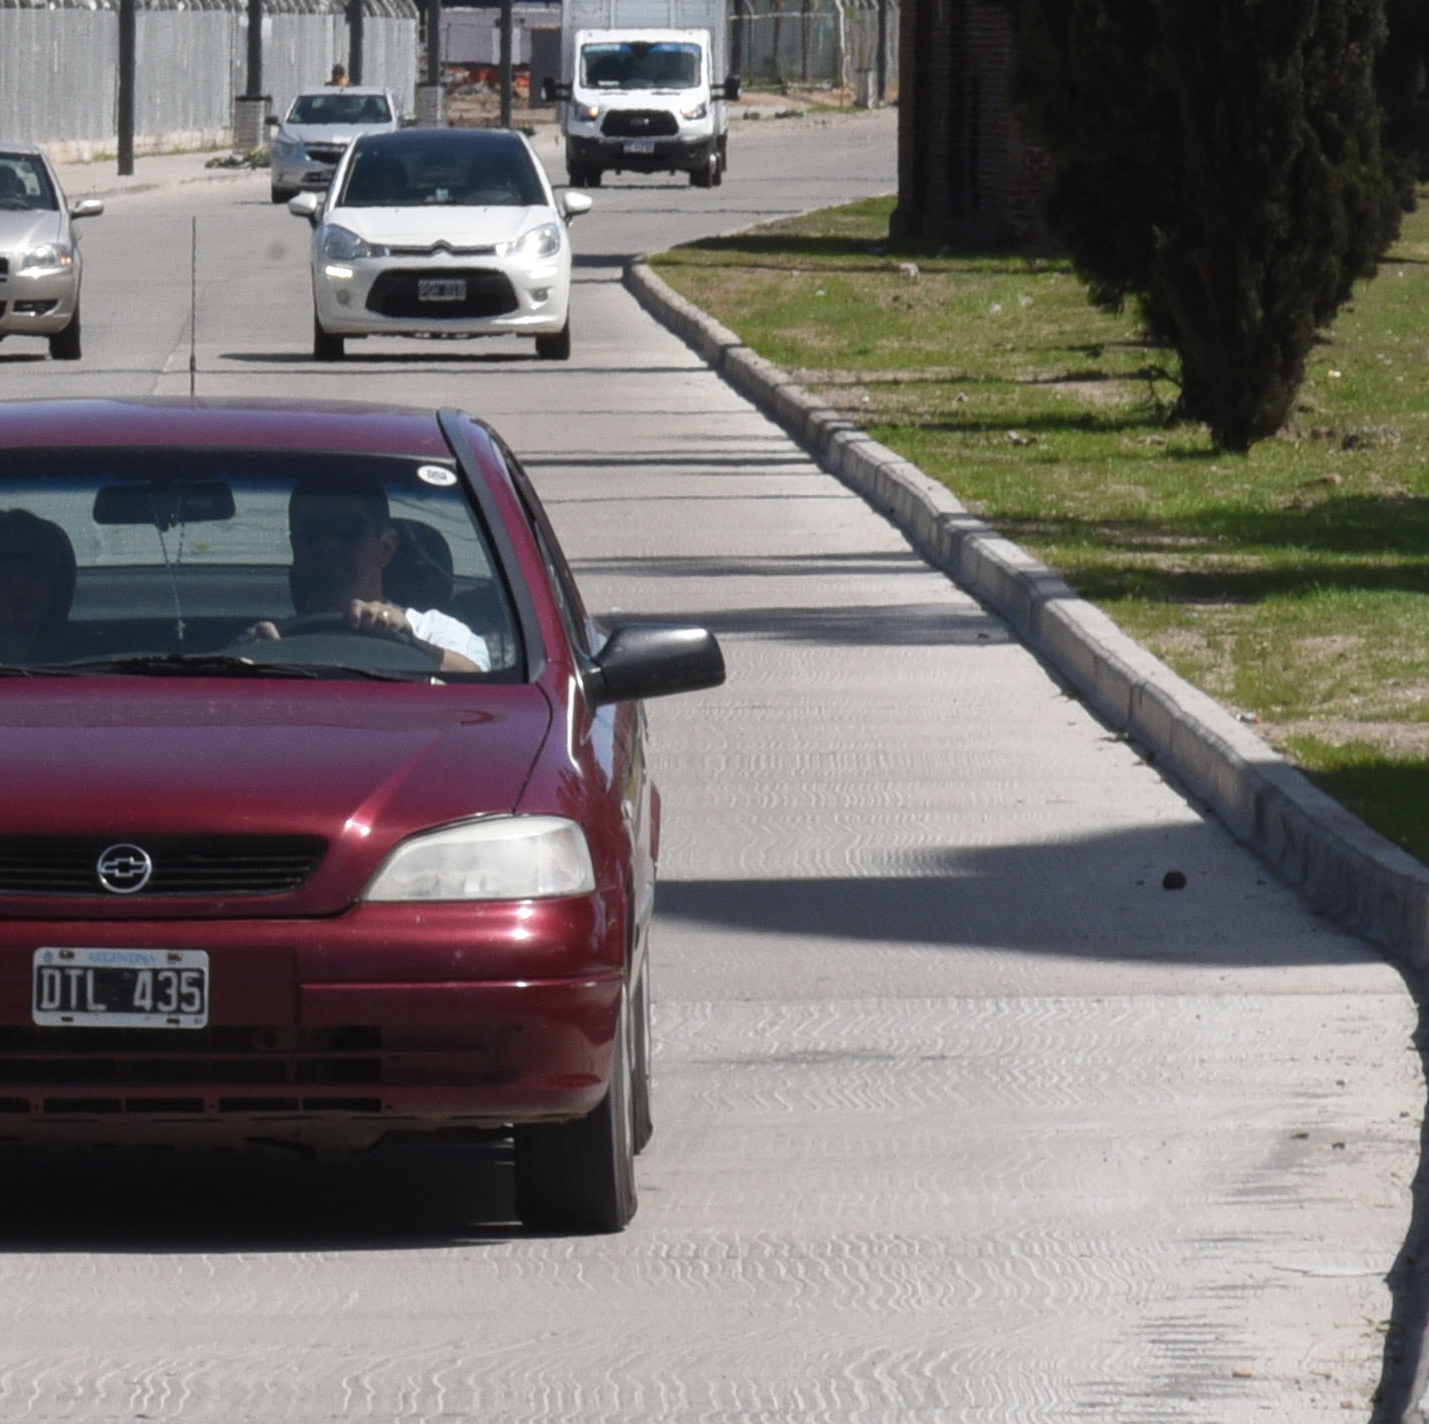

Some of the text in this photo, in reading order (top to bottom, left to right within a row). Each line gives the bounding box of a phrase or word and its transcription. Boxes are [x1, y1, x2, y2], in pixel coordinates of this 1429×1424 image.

[88, 951, 156, 964] ARGENTINA
[40, 968, 202, 1013] DTL 435
